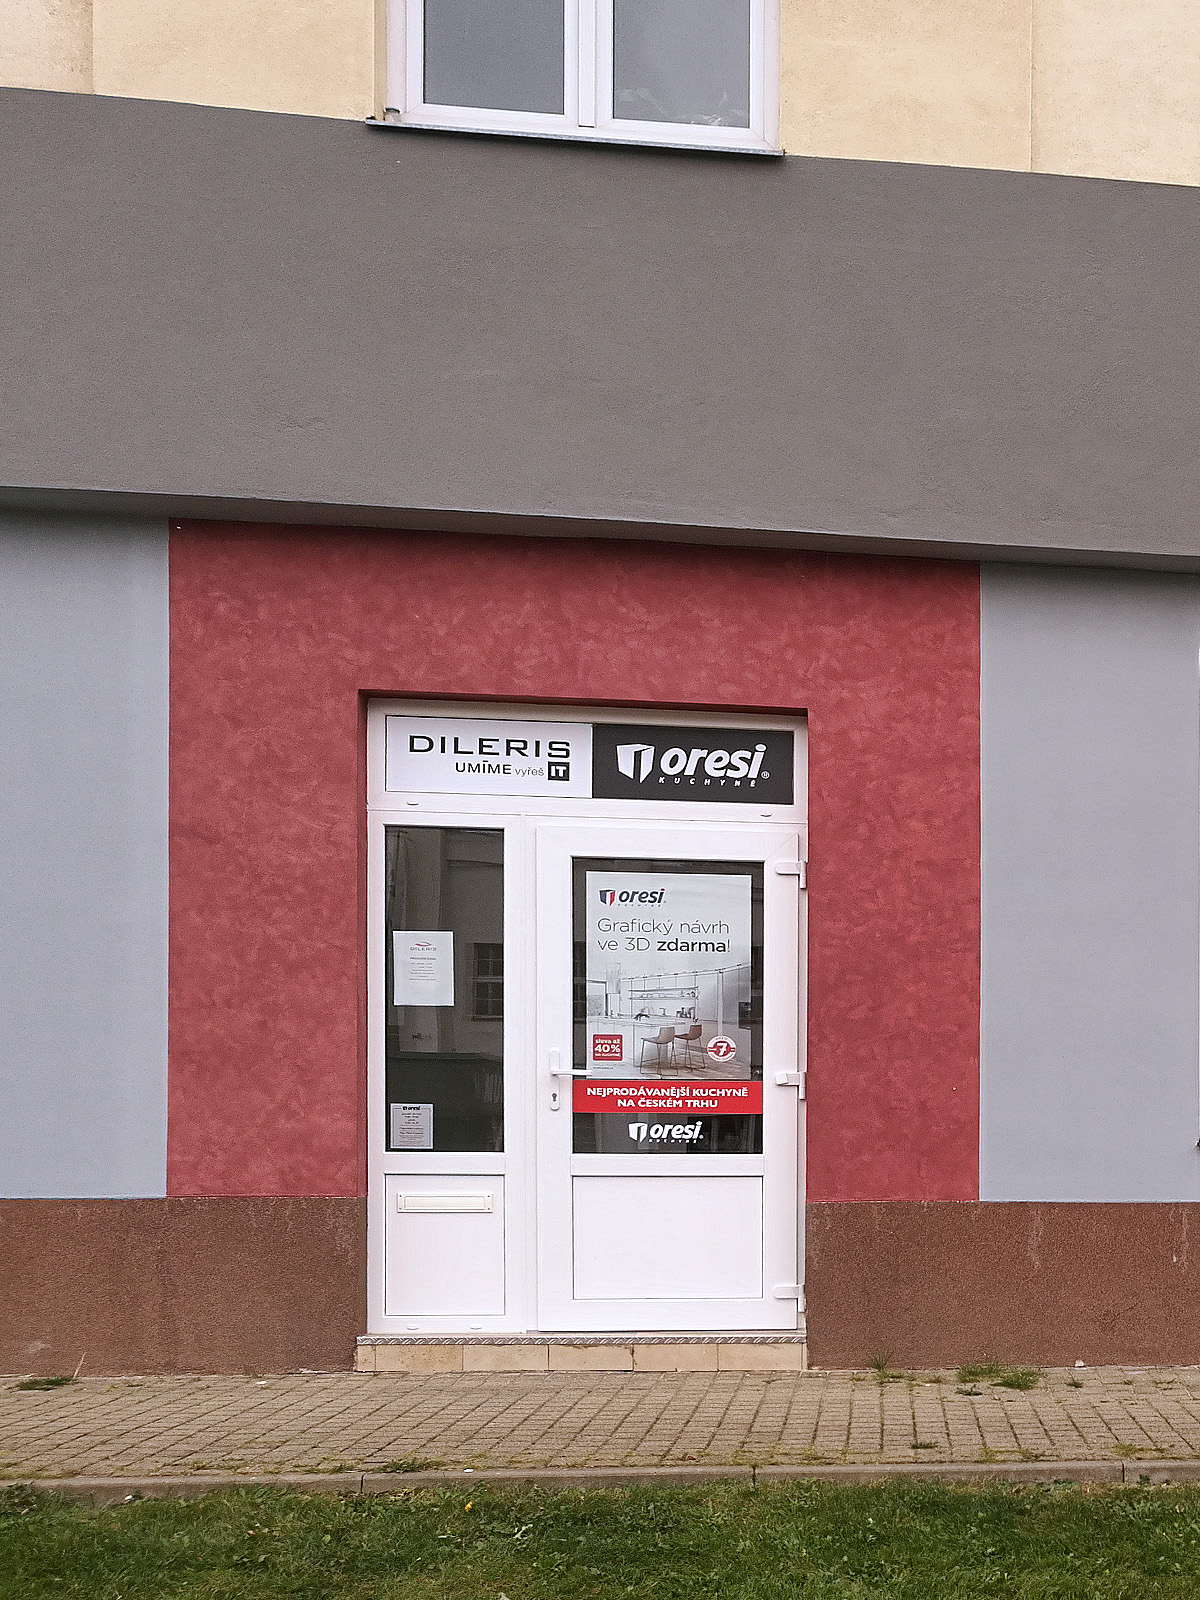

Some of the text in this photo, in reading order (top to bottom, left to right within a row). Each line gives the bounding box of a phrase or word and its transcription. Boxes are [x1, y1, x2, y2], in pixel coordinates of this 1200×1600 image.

[409, 735, 571, 758] DILERIS
[660, 743, 767, 779] oresi
[515, 767, 544, 777] vyřeš
[549, 765, 567, 778] IT
[618, 888, 665, 903] oresi
[597, 917, 730, 936] Grafický návrh
[597, 937, 731, 953] ve 3D zdarma!
[594, 1044, 621, 1053] 40%
[586, 1086, 749, 1098] NEJPRODÁVANĚJŠÍ KUCHYNĚ
[617, 1098, 718, 1108] NA ČESKÉM TRHU
[649, 1120, 703, 1139] oresi
